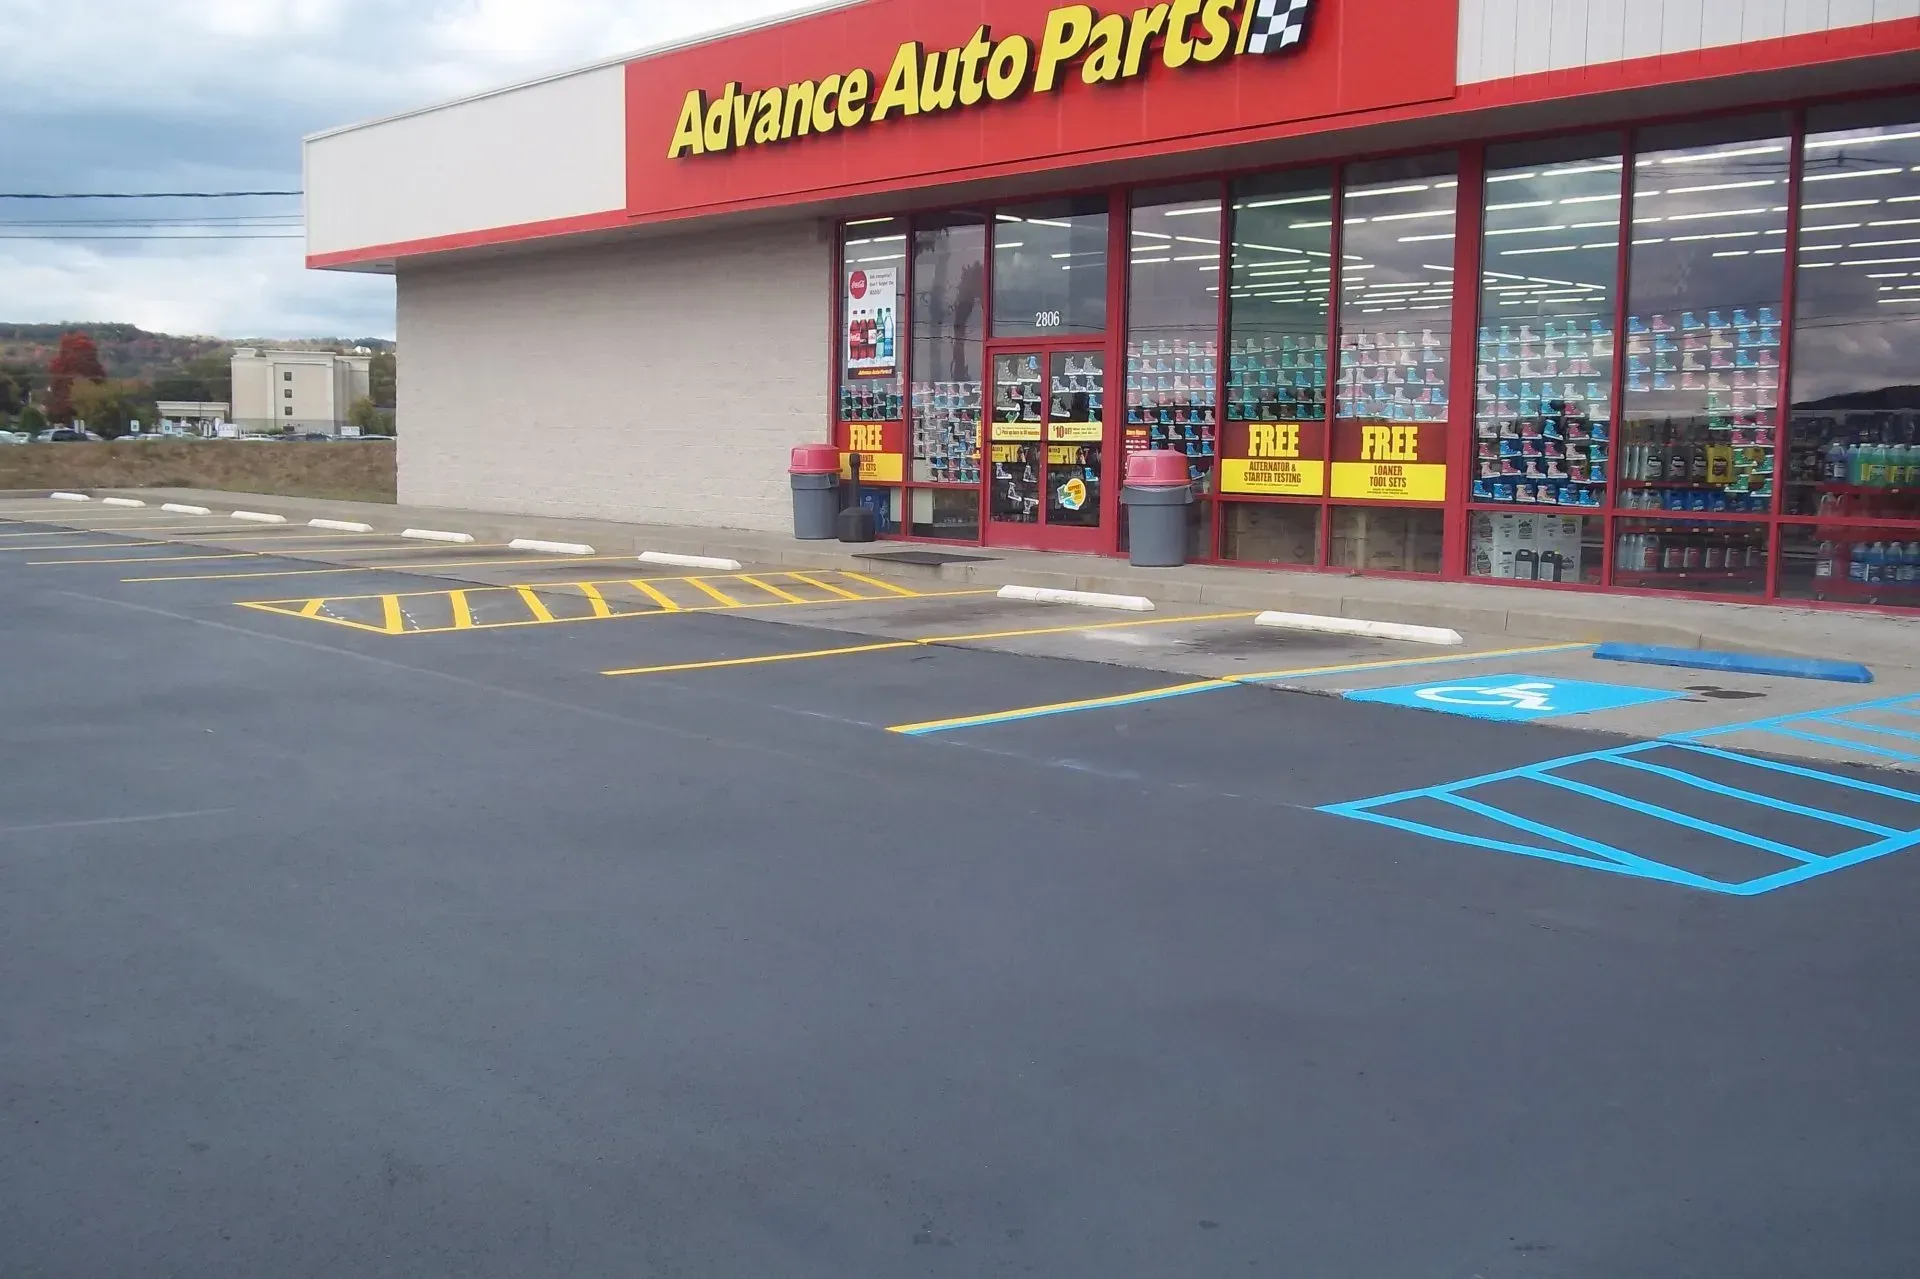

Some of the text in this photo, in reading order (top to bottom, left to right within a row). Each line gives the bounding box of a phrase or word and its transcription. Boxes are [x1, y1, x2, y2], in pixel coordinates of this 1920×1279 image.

[667, 0, 1235, 159] Advance Auto Parts
[1035, 310, 1060, 327] 2806
[849, 424, 883, 451] FREE
[1248, 424, 1299, 457] FREE
[1361, 426, 1418, 460] FREE
[1249, 460, 1296, 472] ALTERNATOR &
[1374, 465, 1403, 476] LOANER
[1243, 471, 1301, 484] STARTER TESTING
[1370, 476, 1407, 488] TOOL SETS
